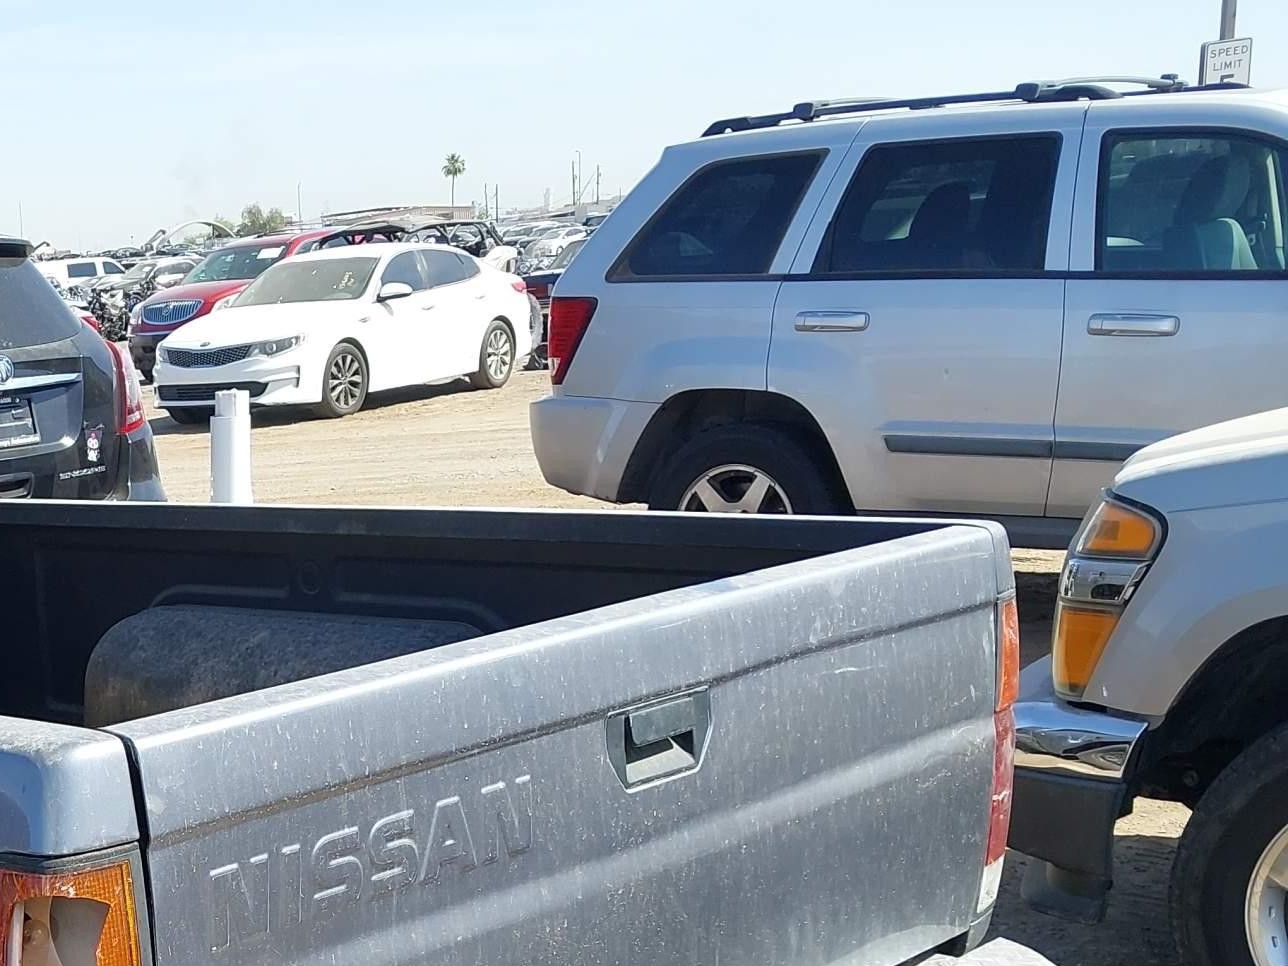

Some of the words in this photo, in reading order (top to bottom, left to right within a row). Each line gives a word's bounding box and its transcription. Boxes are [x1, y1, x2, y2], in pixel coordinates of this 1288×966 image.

[1210, 45, 1249, 59] SPEED
[1213, 59, 1243, 71] LIMIT
[209, 774, 535, 953] NISSAN
